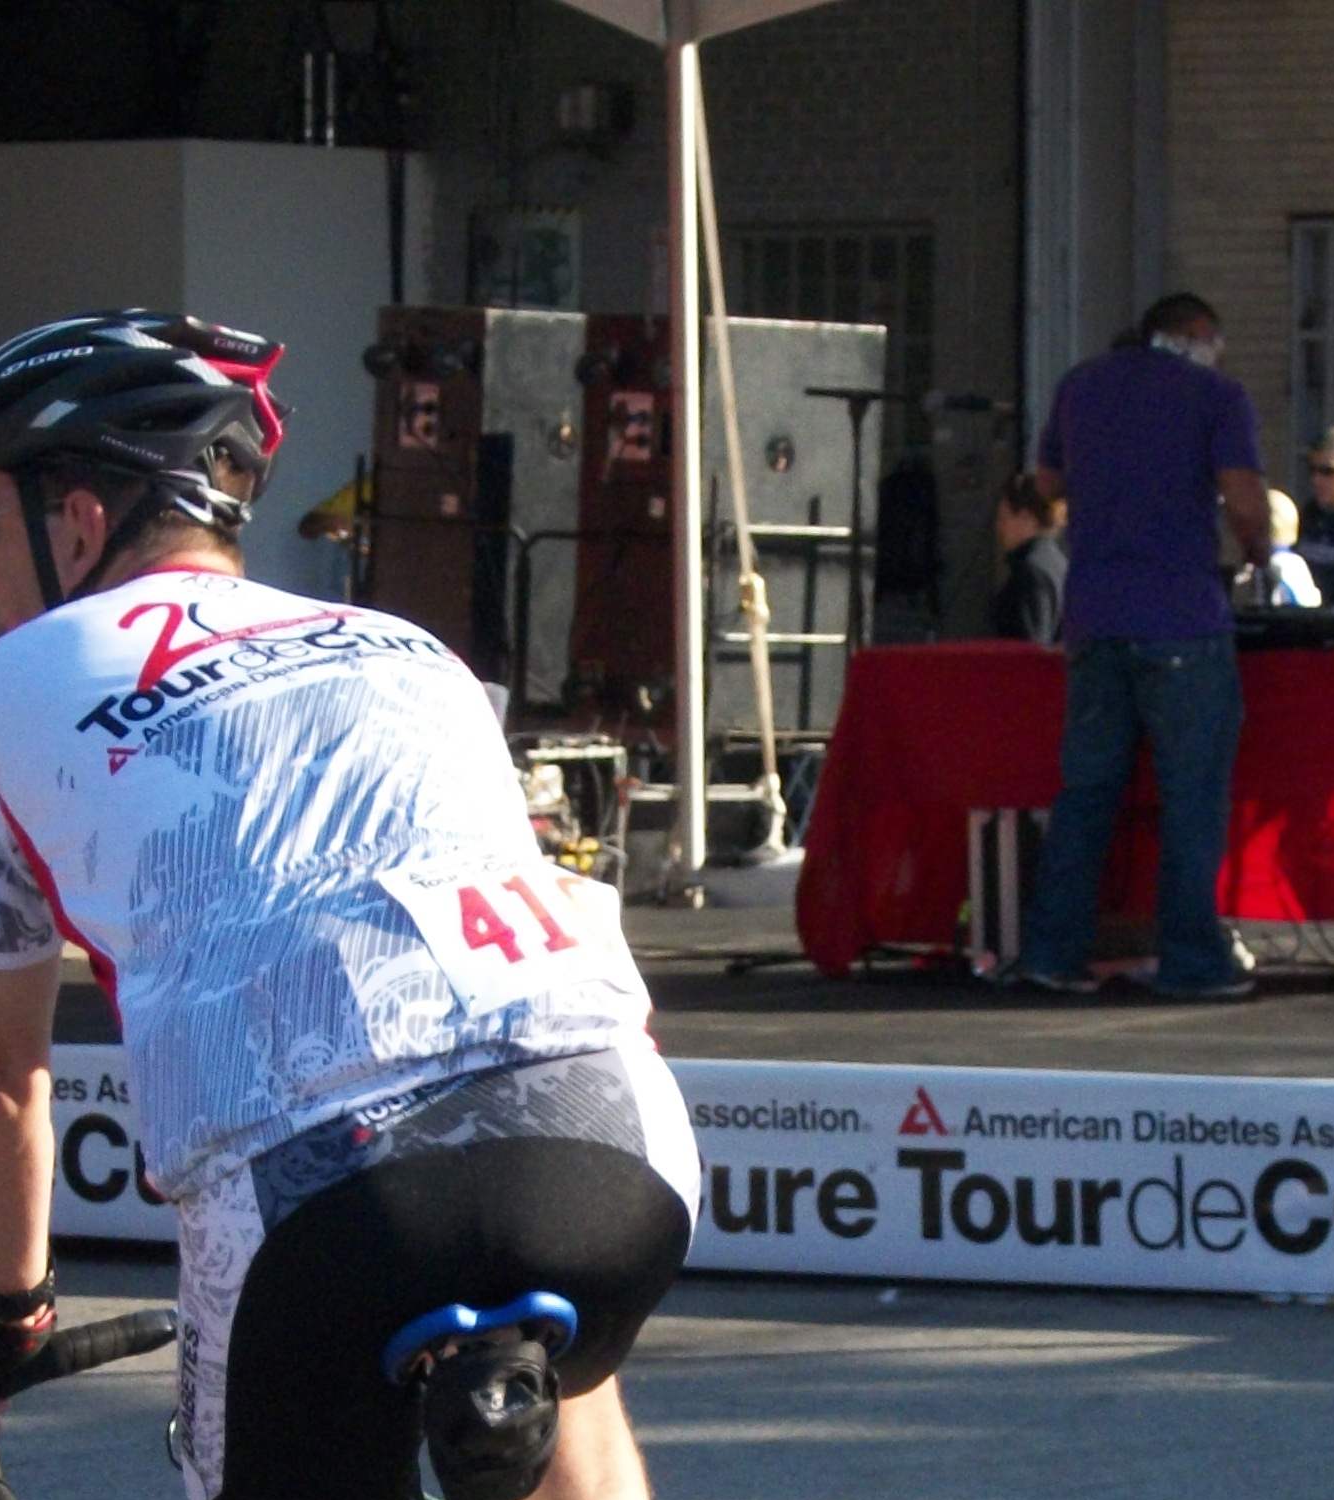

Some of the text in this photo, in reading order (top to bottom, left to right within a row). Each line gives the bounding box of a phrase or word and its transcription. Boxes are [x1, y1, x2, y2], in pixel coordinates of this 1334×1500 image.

[26, 345, 95, 368] GIRO
[689, 1098, 860, 1134] ssociation
[964, 1105, 1122, 1143] American
[1133, 1110, 1280, 1147] Diabetes
[181, 1322, 199, 1460] DIABETES
